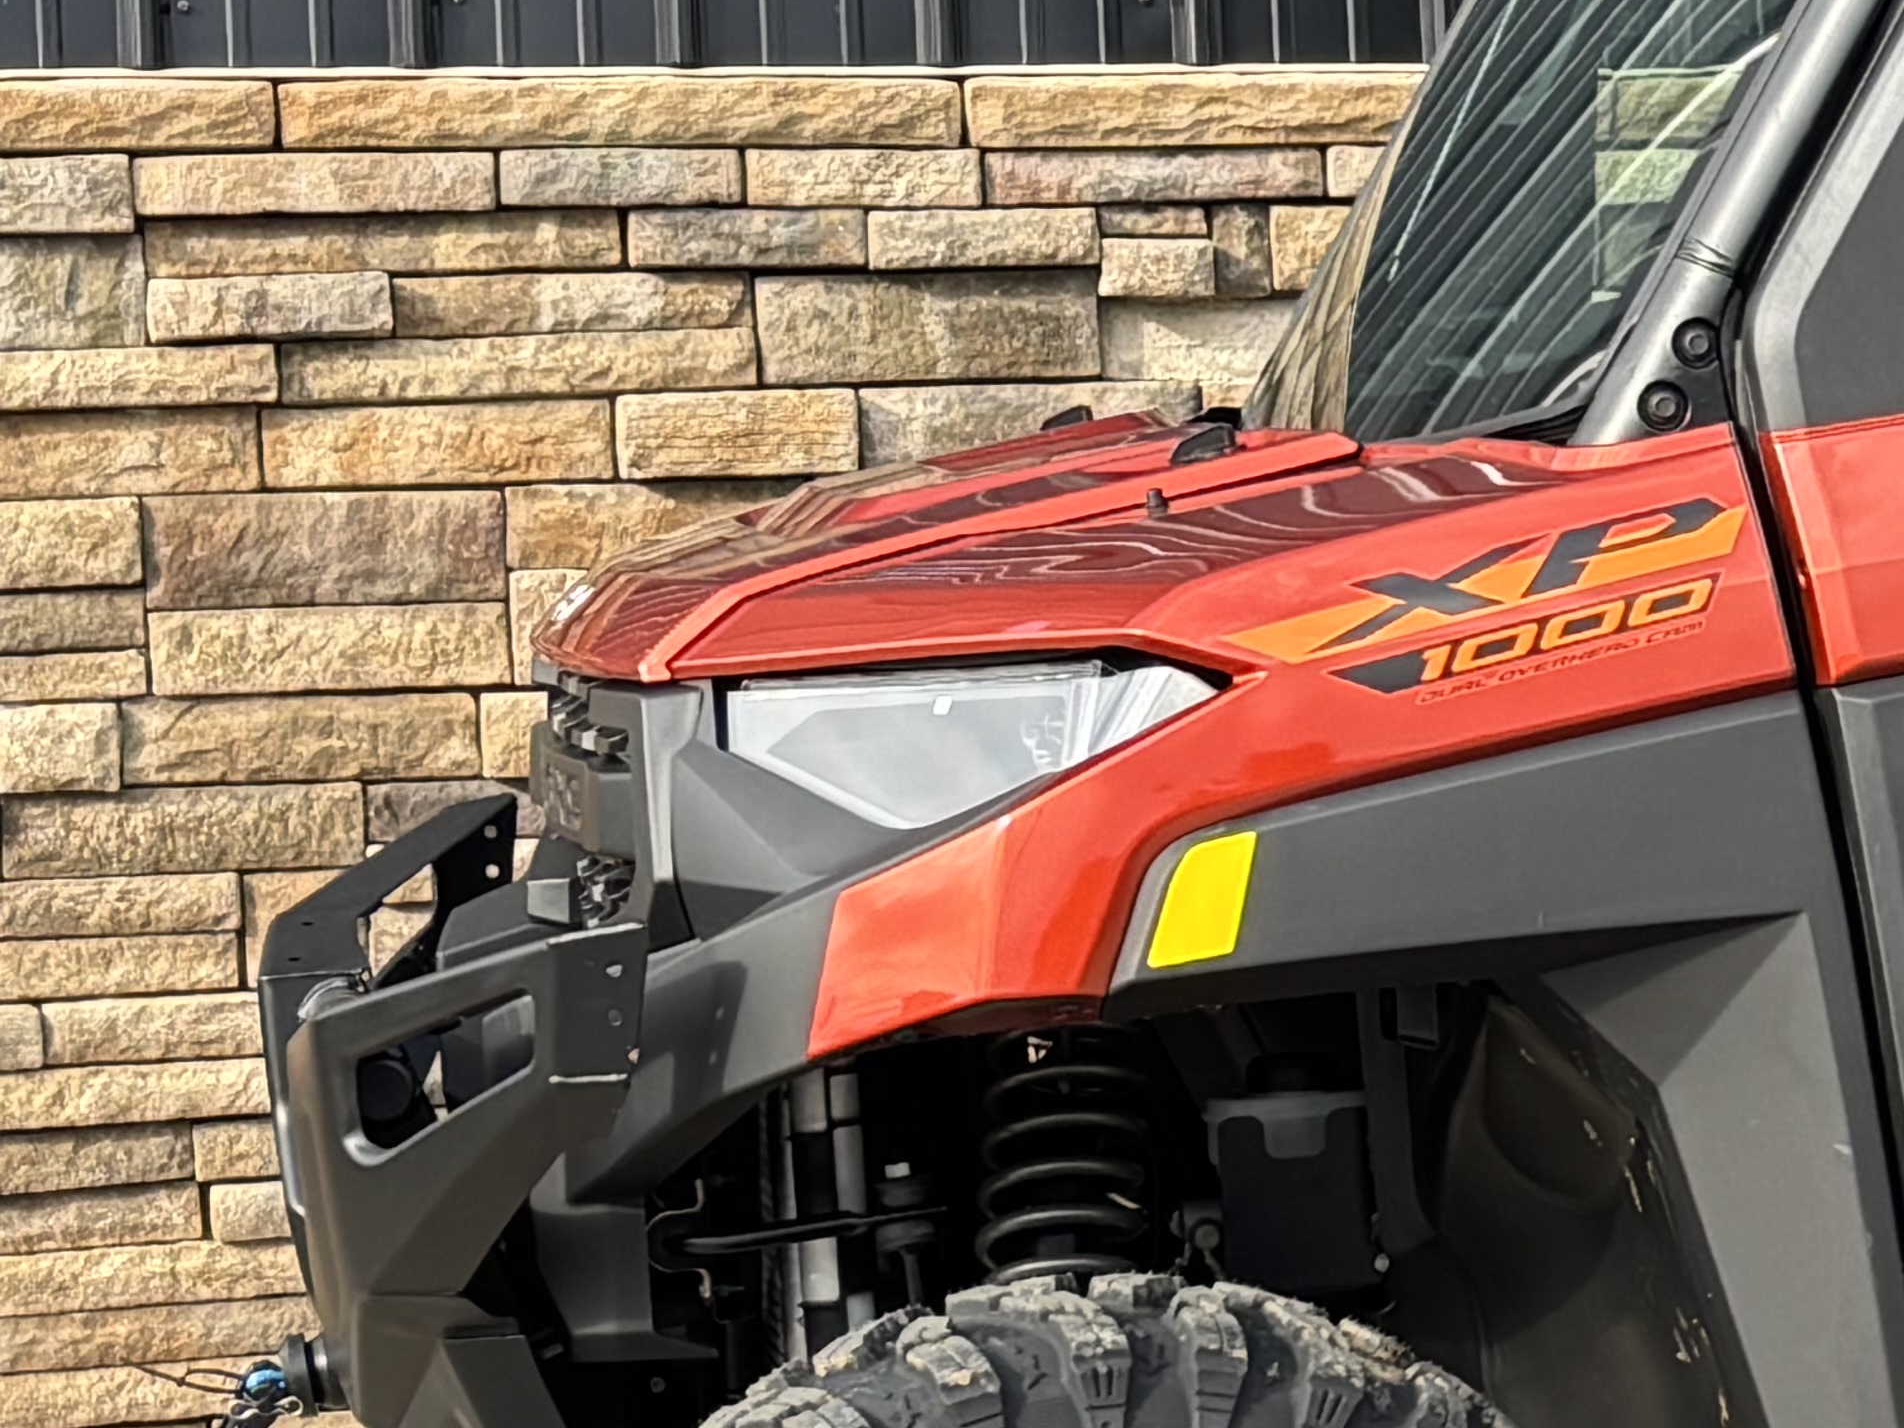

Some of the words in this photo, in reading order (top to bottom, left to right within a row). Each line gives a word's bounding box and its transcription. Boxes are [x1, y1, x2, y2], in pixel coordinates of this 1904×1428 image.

[1312, 497, 1729, 655] XP
[1420, 577, 1714, 682] 1000
[1420, 680, 1488, 703] DUAL
[1498, 637, 1641, 681] OVERHEAD
